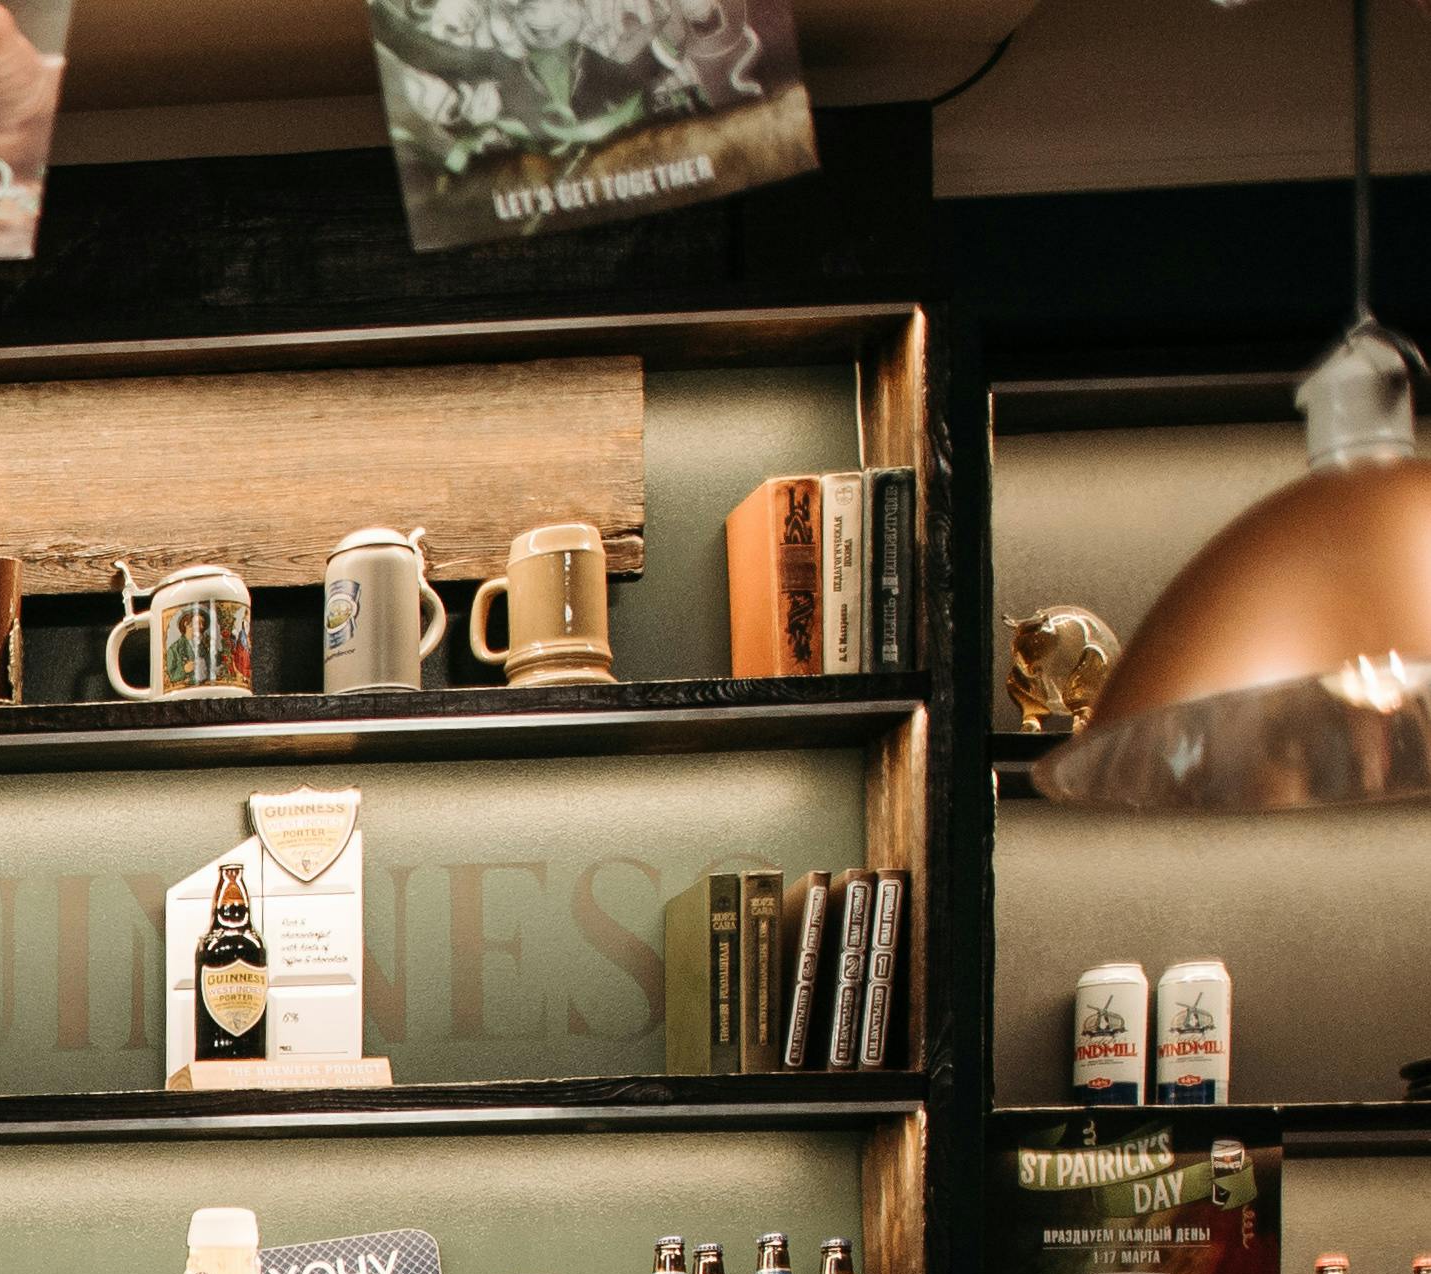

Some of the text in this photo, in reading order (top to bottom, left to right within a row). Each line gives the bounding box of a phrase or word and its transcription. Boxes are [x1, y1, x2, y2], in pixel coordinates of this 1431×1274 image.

[493, 155, 716, 220] LET'S GET TOGETHER
[264, 803, 346, 818] GUINNESS
[282, 828, 326, 839] PORTER
[802, 956, 816, 978] 3
[845, 956, 859, 978] 2
[877, 956, 888, 977] 1
[218, 993, 254, 1001] PORTER
[1021, 1131, 1173, 1186] ST PATRICK'S
[1133, 1172, 1185, 1215] DAY
[1043, 1229, 1114, 1245] ПРАЗДНУЕМ
[1118, 1226, 1172, 1243] КАЖДЫЙ
[1121, 1249, 1161, 1265] МАРТА
